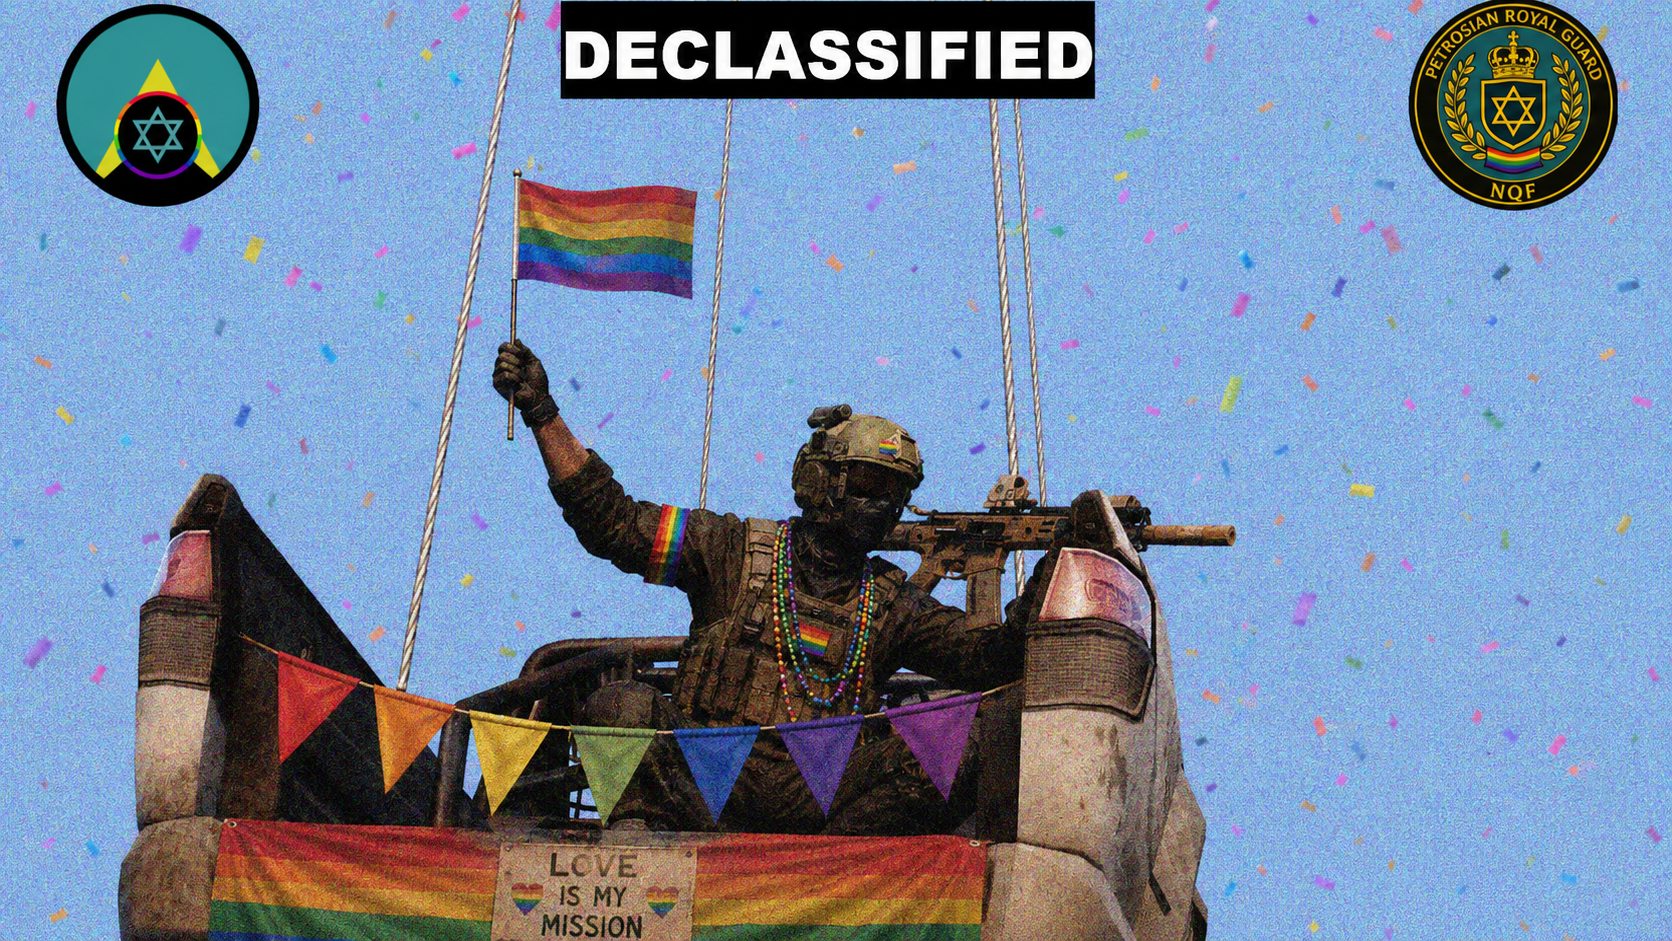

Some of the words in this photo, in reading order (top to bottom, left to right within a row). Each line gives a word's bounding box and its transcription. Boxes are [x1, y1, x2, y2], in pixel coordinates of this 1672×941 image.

[550, 852, 638, 878] LOVE
[559, 885, 580, 907] IS
[593, 886, 627, 908] MY
[540, 914, 642, 939] MISSION
